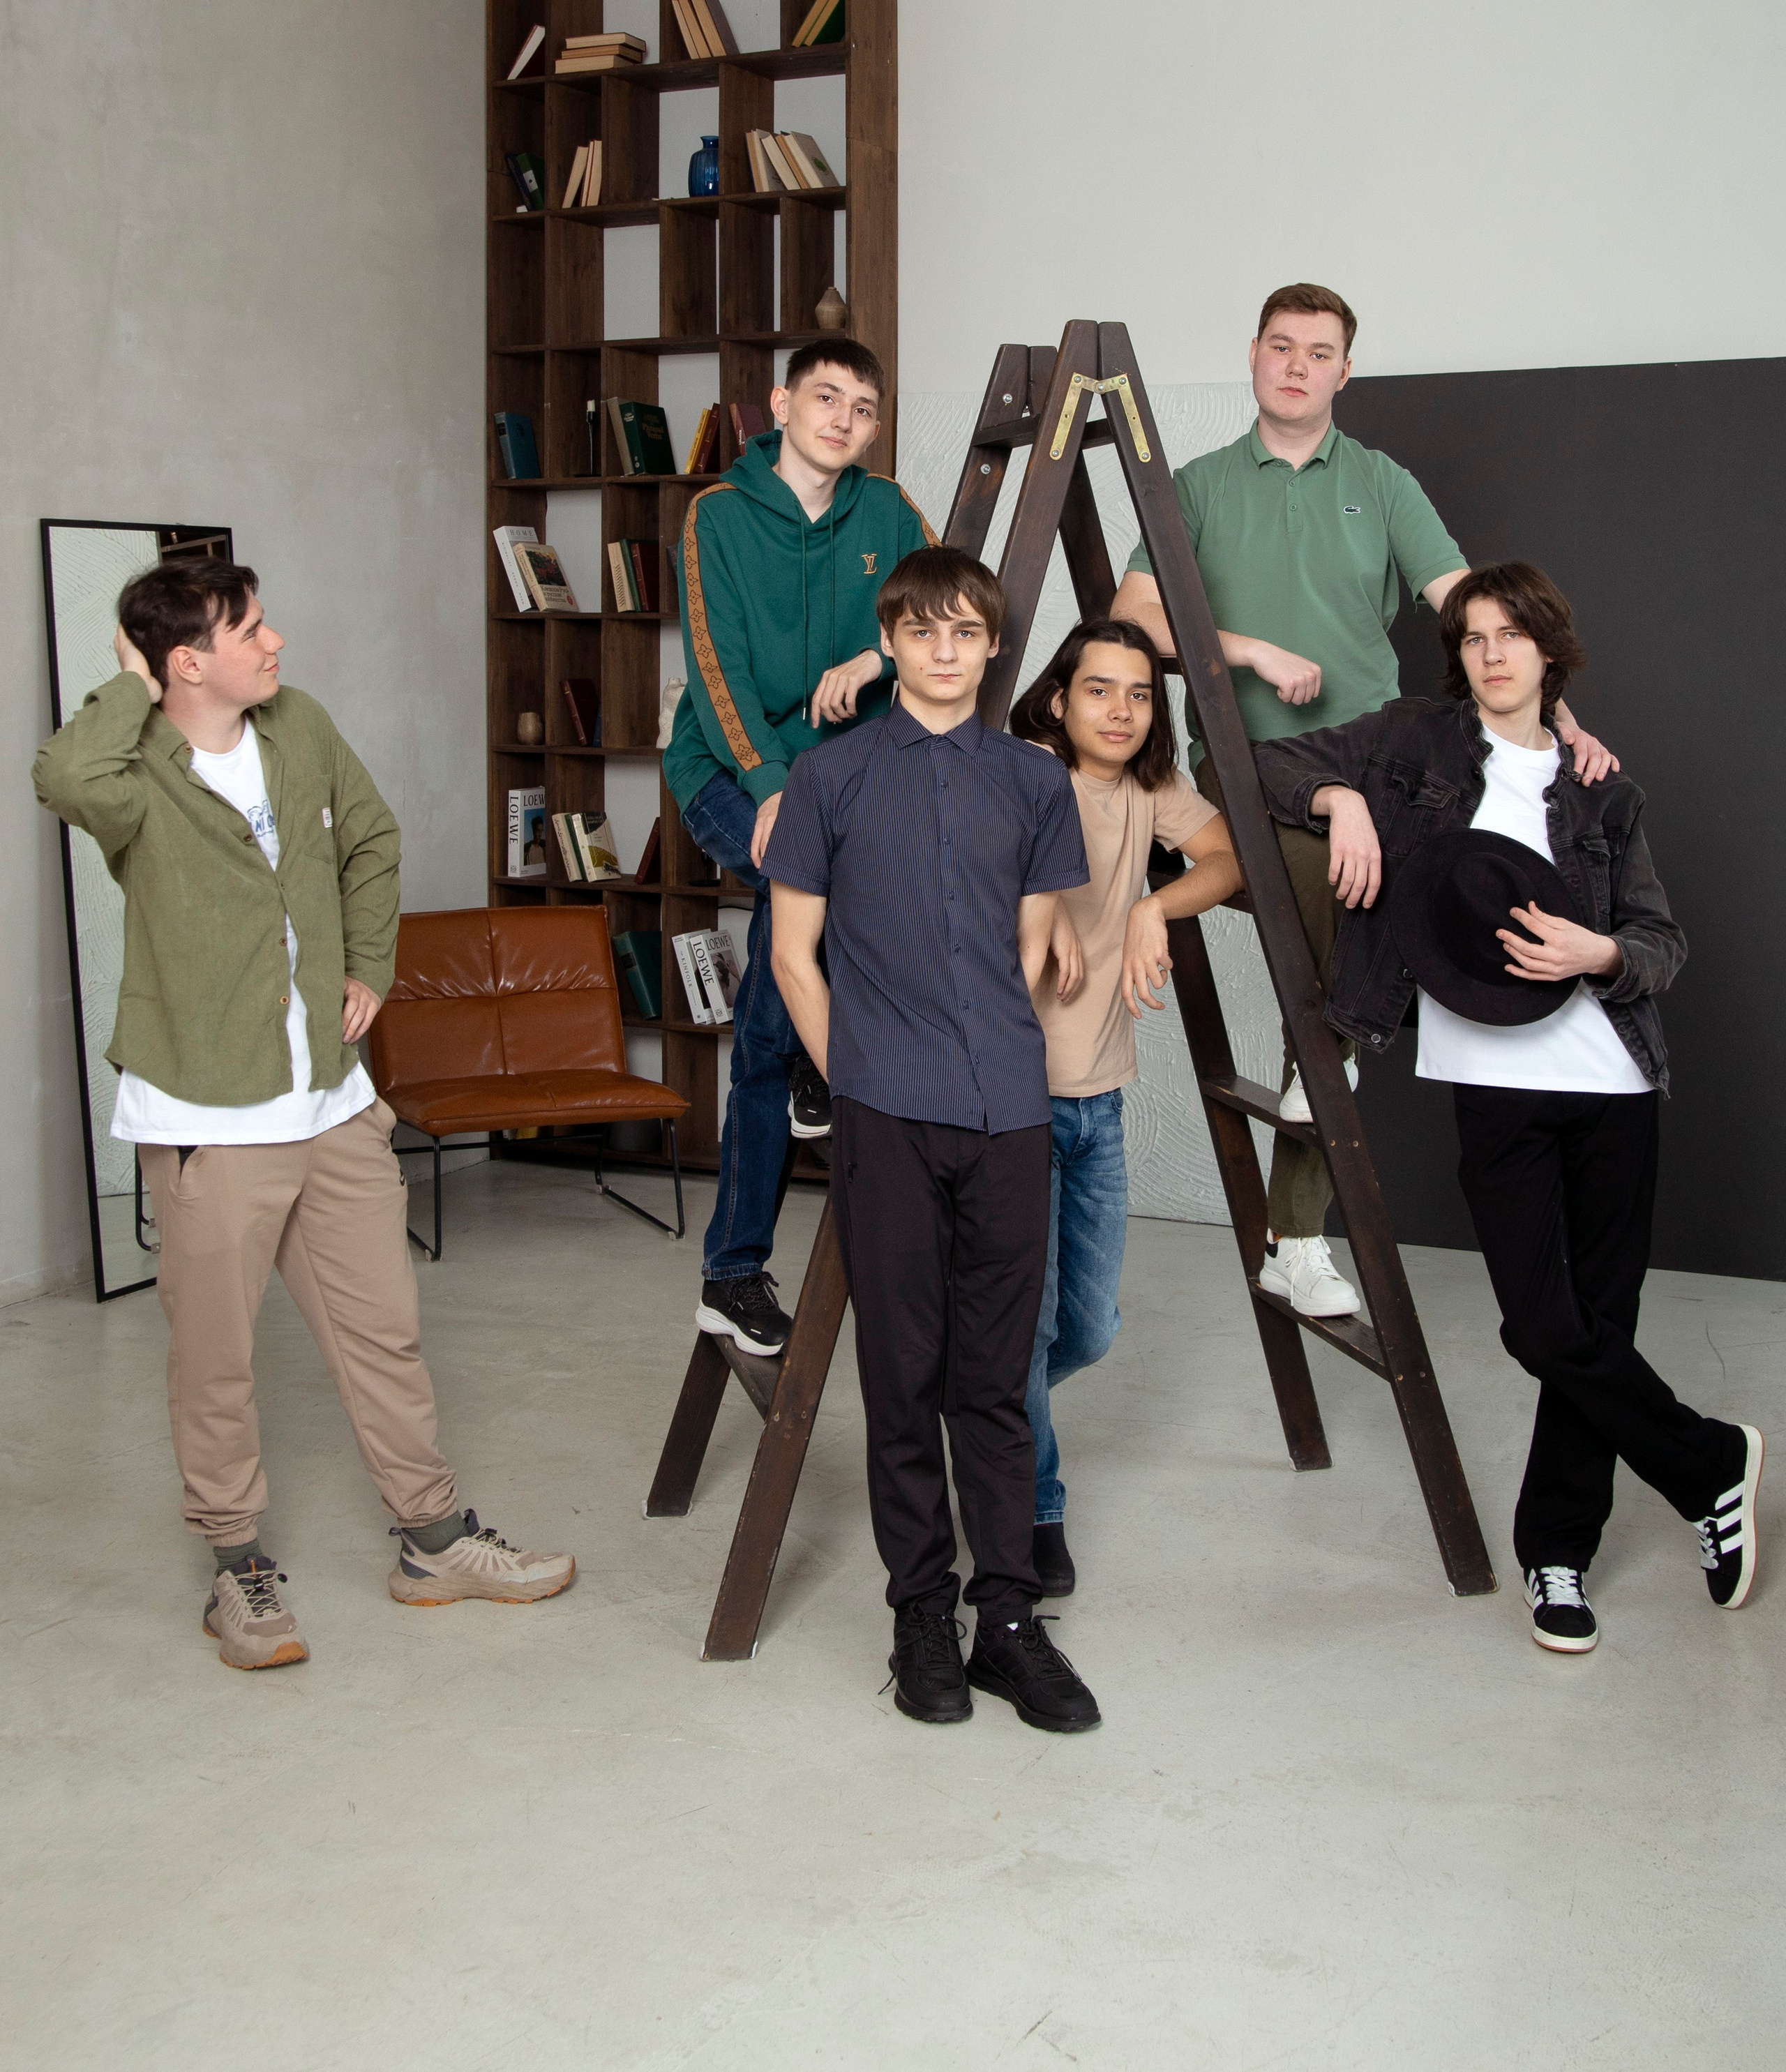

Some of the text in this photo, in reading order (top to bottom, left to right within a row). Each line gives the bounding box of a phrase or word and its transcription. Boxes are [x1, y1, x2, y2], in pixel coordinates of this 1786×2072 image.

[523, 793, 545, 806] LOEW
[509, 796, 519, 845] LOEWE
[705, 935, 730, 951] LOEWE
[681, 957, 693, 988] KINFOLK
[693, 941, 714, 986] LOEWE
